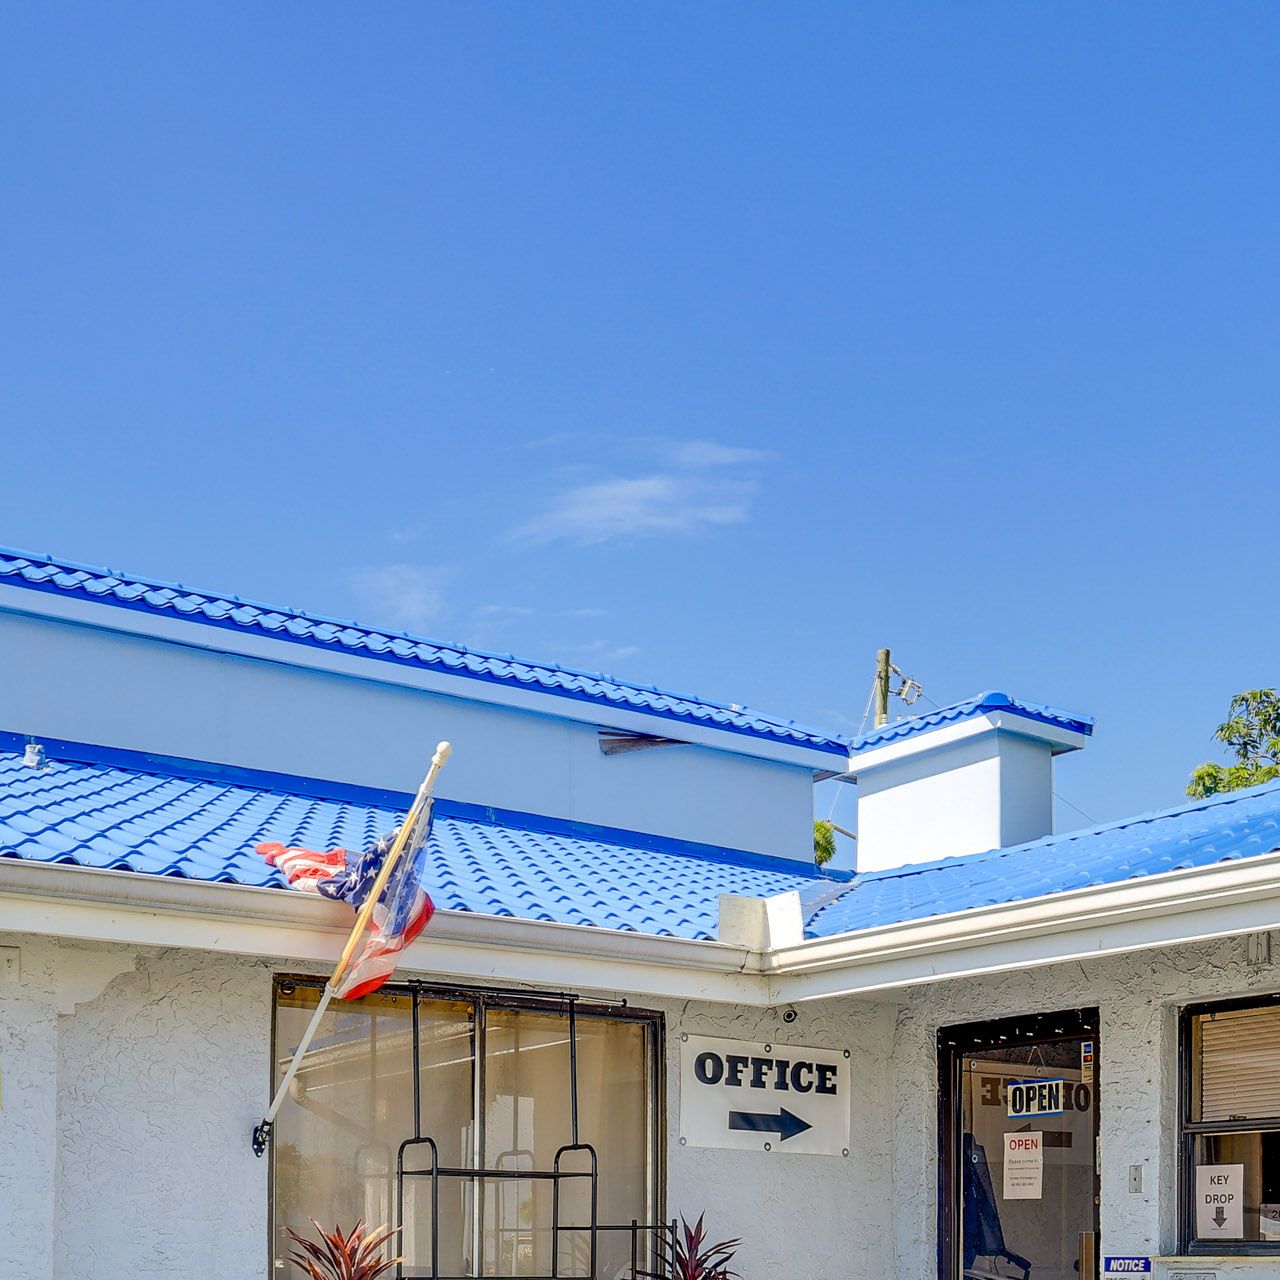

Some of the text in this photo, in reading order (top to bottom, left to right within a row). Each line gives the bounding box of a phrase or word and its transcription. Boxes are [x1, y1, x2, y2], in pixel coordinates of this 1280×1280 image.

[694, 1052, 838, 1095] OFFICE
[1011, 1083, 1060, 1114] OPEN
[1009, 1139, 1038, 1150] OPEN
[1210, 1175, 1229, 1185] KEY
[1205, 1194, 1234, 1204] DROP
[1110, 1260, 1145, 1271] NOTICE
